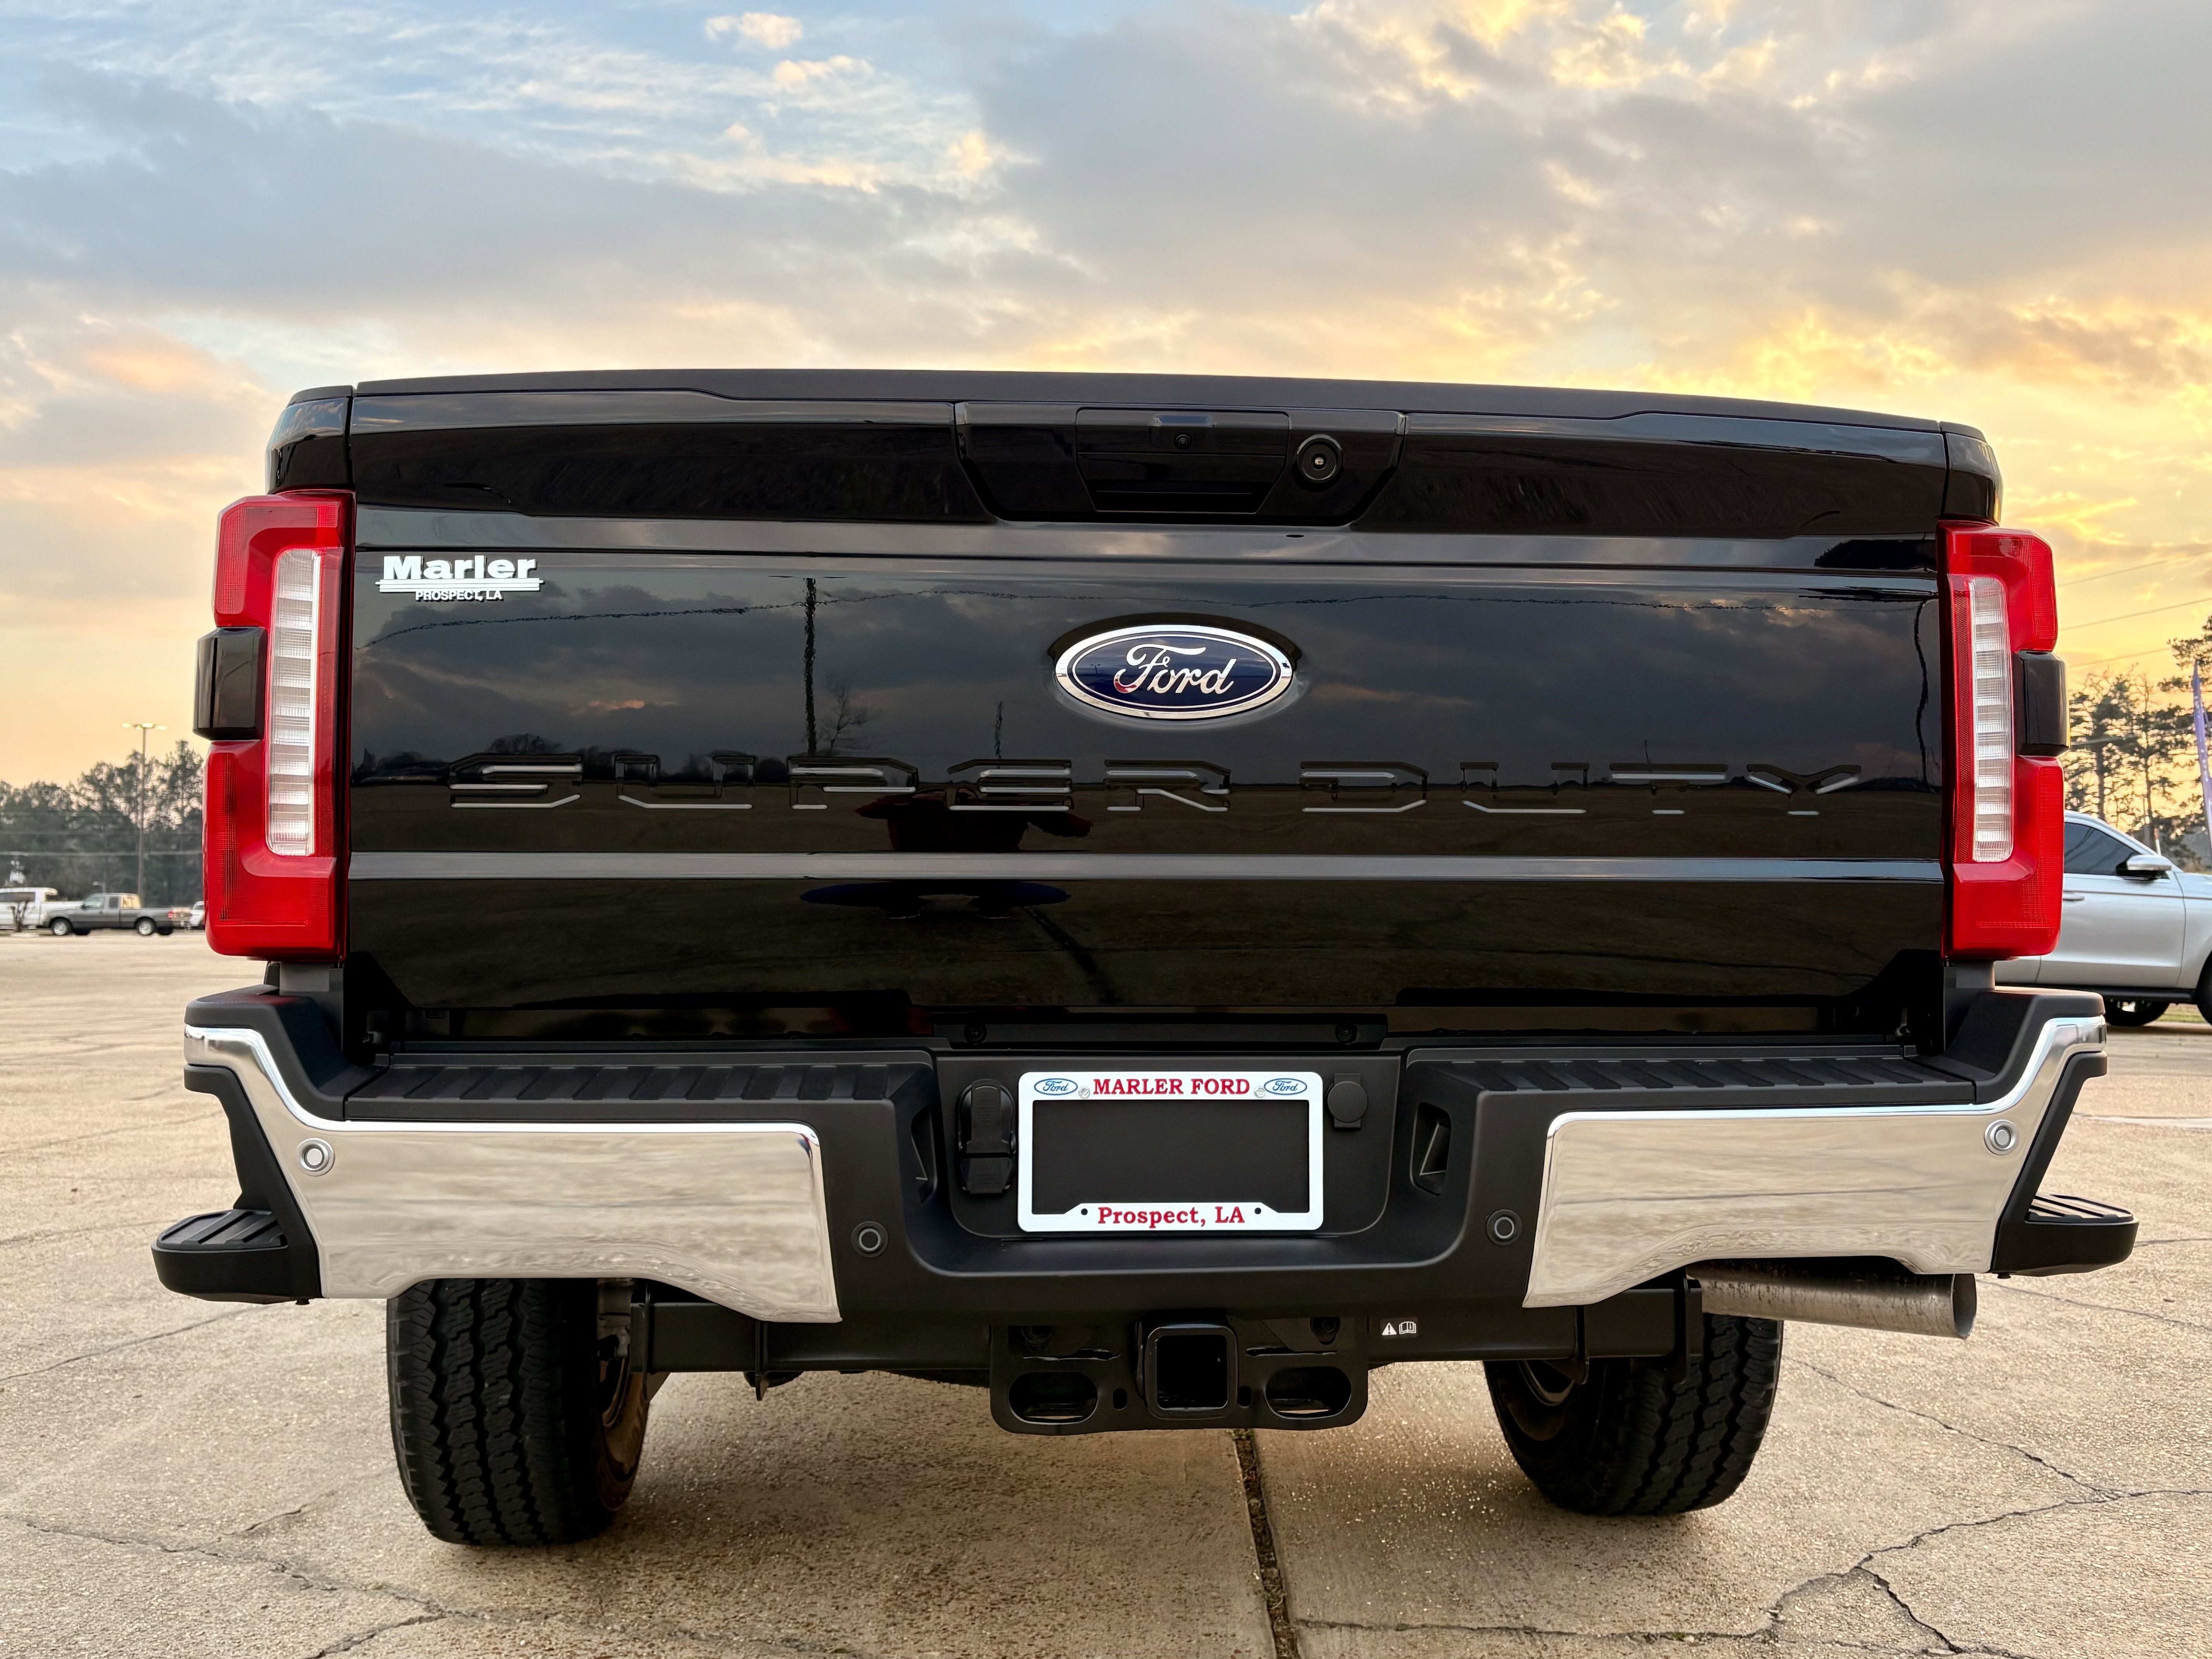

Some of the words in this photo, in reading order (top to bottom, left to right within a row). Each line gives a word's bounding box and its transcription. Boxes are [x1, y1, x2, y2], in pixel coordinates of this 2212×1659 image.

[383, 555, 537, 580] Marler
[416, 591, 484, 601] PROSPECT,
[486, 590, 503, 600] LA
[1113, 644, 1237, 694] Ford
[449, 756, 1231, 812] SUPER
[1300, 761, 1862, 816] DUTY
[1042, 1080, 1069, 1092] Ford
[1093, 1079, 1184, 1095] MARLER
[1190, 1079, 1250, 1094] FORD
[1273, 1080, 1298, 1092] Ford
[1097, 1206, 1206, 1228] Prospect,
[1215, 1206, 1245, 1224] LA
